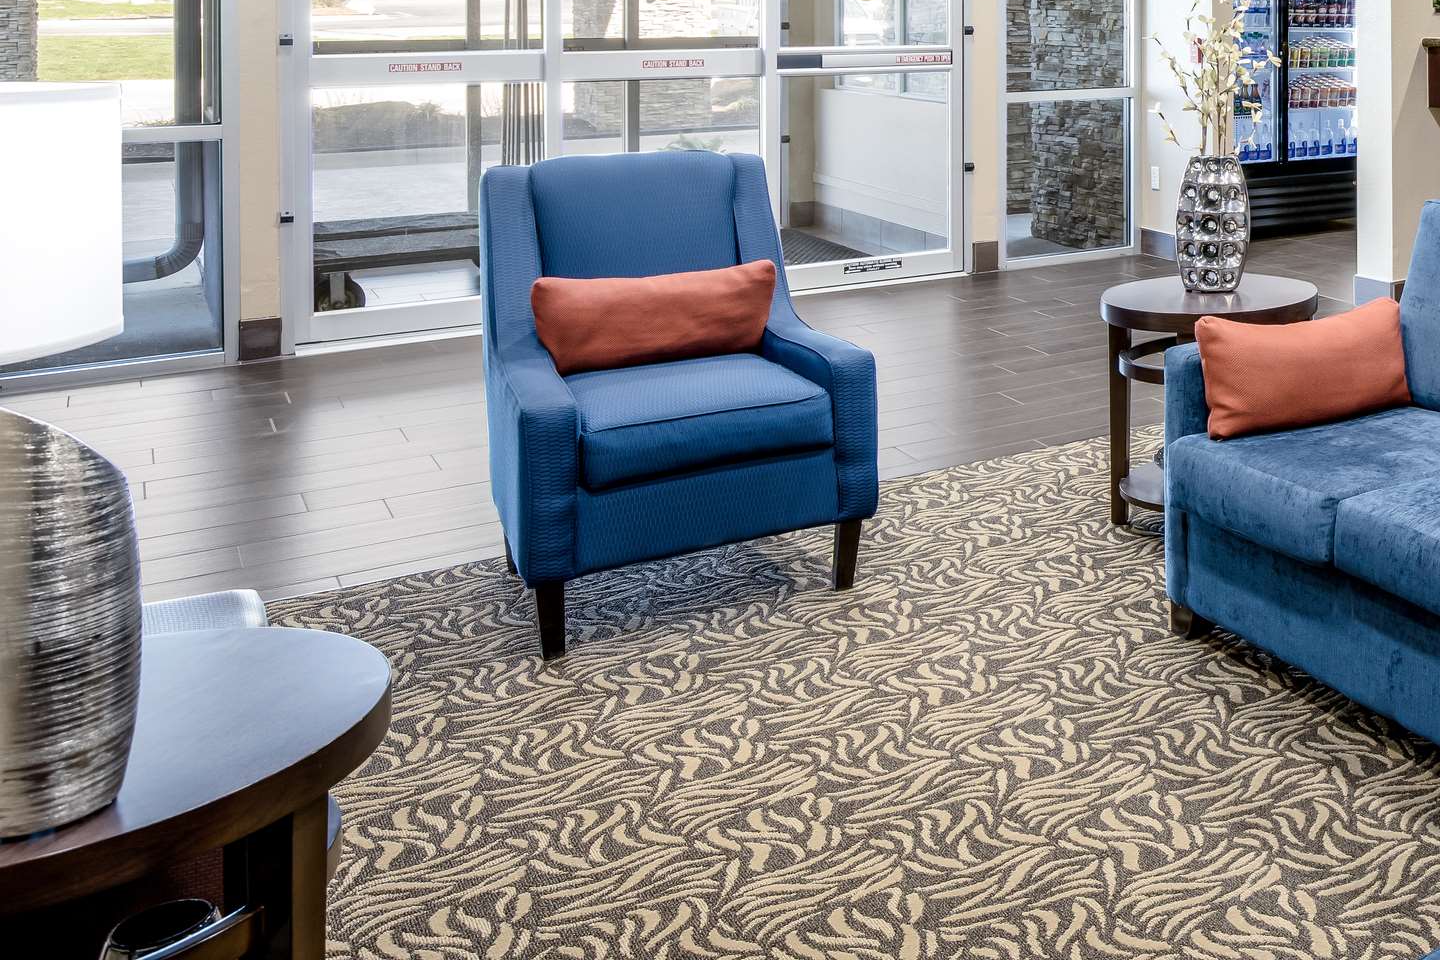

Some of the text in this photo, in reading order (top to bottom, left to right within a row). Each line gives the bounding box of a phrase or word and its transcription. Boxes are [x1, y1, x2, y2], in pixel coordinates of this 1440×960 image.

[389, 62, 461, 72] CAUTION STAND BACK
[643, 60, 668, 68] CAUTION
[689, 59, 704, 67] BACK
